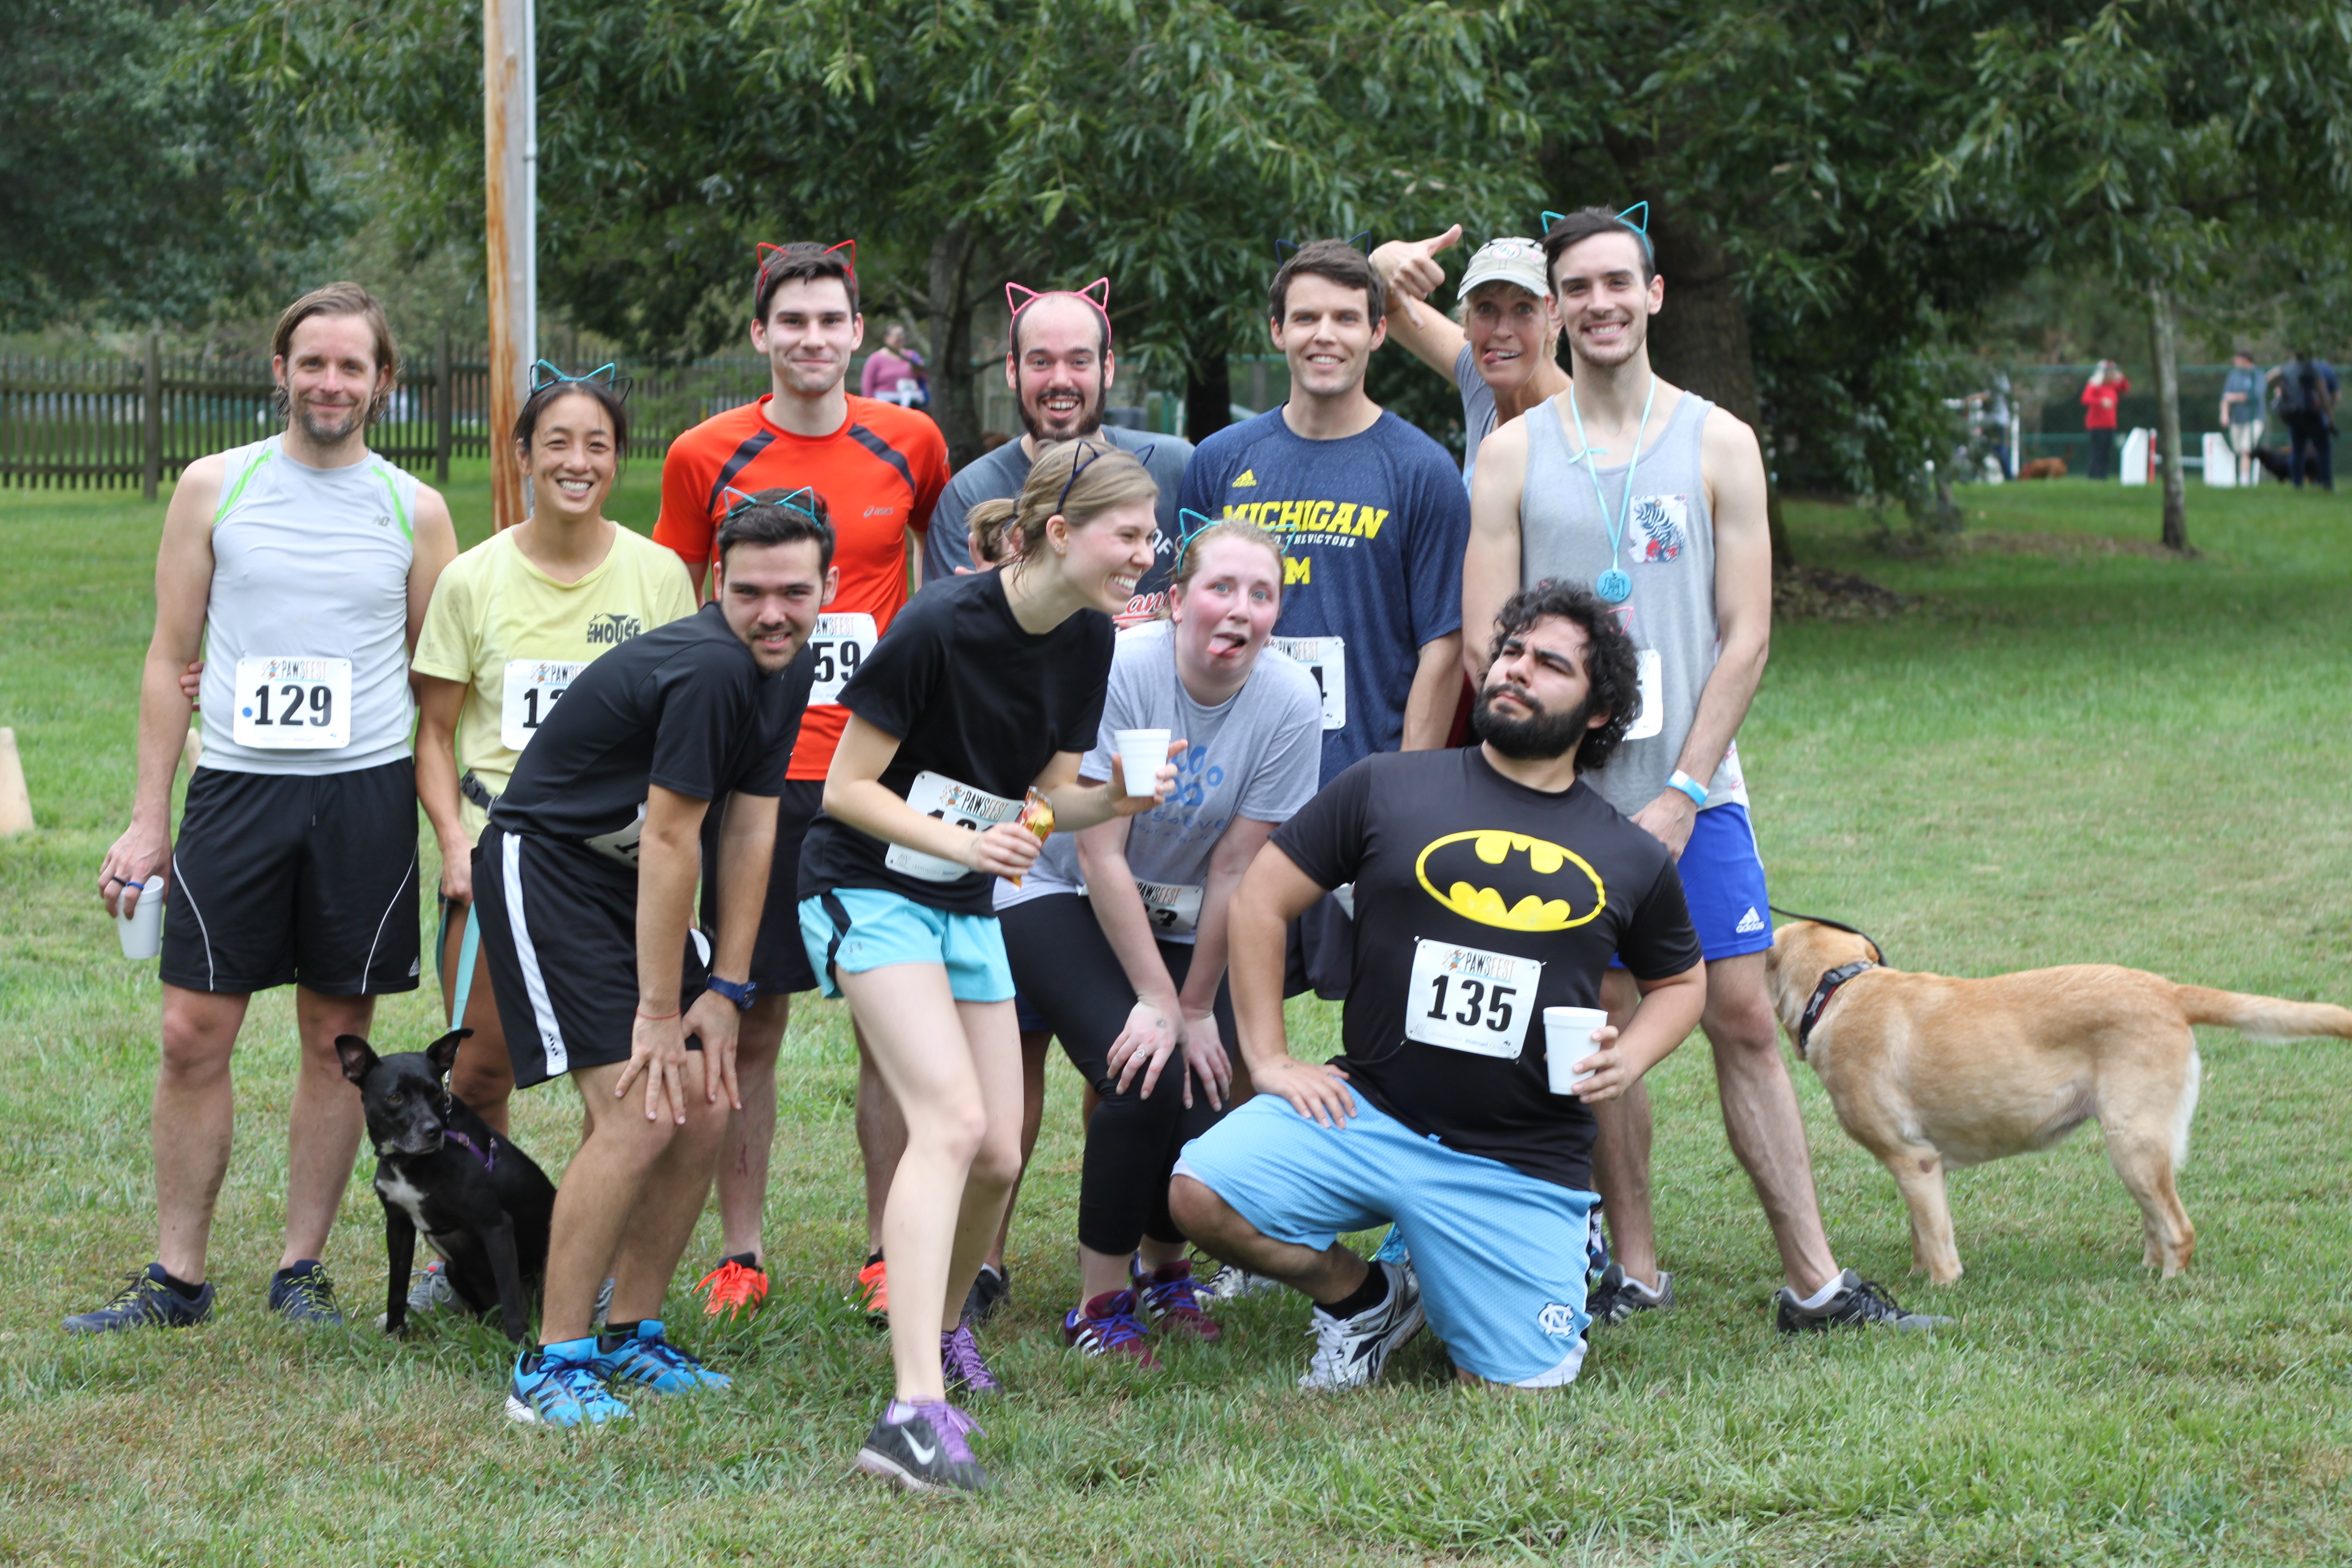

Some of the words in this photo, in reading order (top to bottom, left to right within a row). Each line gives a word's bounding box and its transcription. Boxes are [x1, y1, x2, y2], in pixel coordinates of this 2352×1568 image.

[1283, 556, 1311, 585] M
[281, 659, 327, 680] PAWSFEST
[254, 684, 332, 727] 129
[961, 790, 1010, 820] PAWSFEST
[1137, 882, 1182, 905] PAWSFEST
[1464, 952, 1517, 980] PAWSFEST
[1427, 974, 1518, 1031] 135
